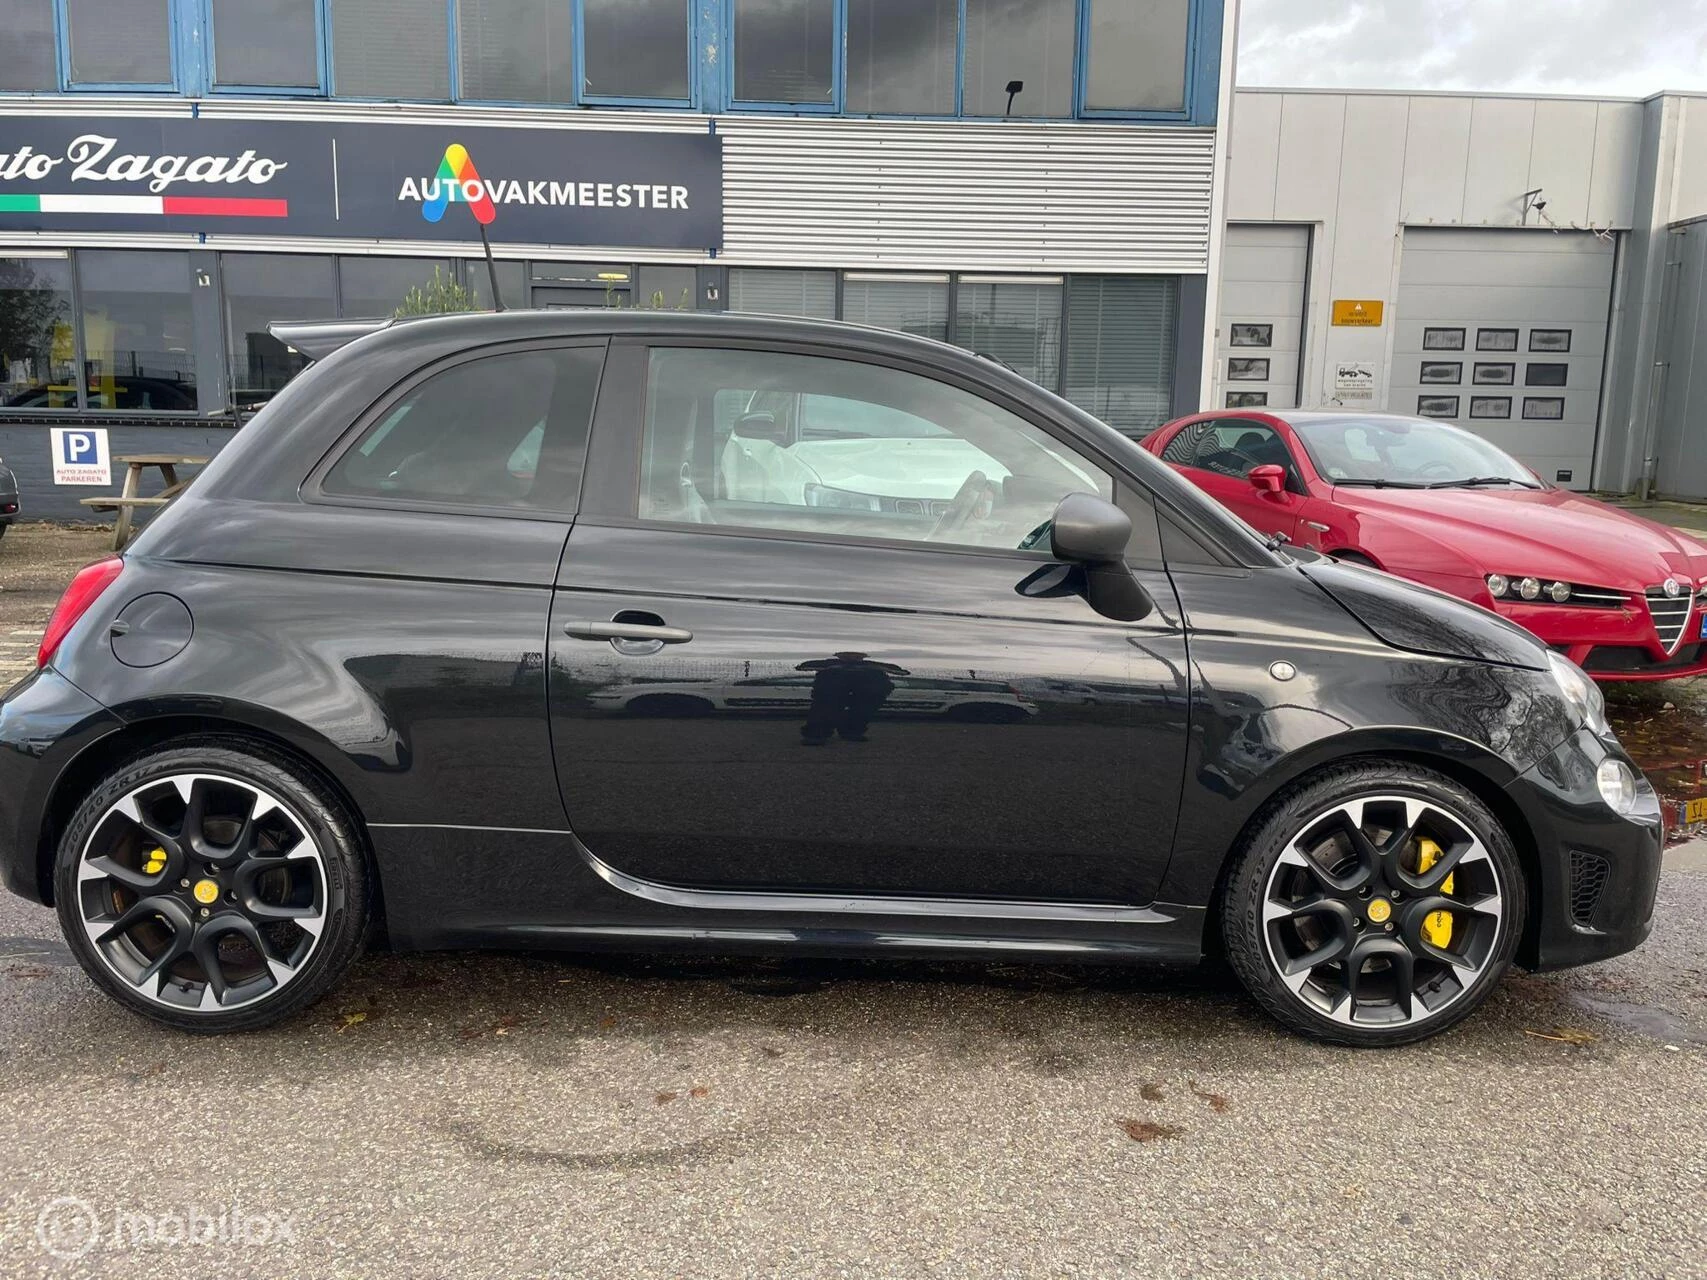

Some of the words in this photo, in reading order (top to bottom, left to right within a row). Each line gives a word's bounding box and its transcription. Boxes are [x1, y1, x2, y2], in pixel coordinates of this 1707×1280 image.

[67, 134, 288, 193] Zagato
[397, 176, 690, 210] AUTOVAKMEESTER
[68, 433, 91, 462] P
[61, 475, 102, 483] PARKEREN
